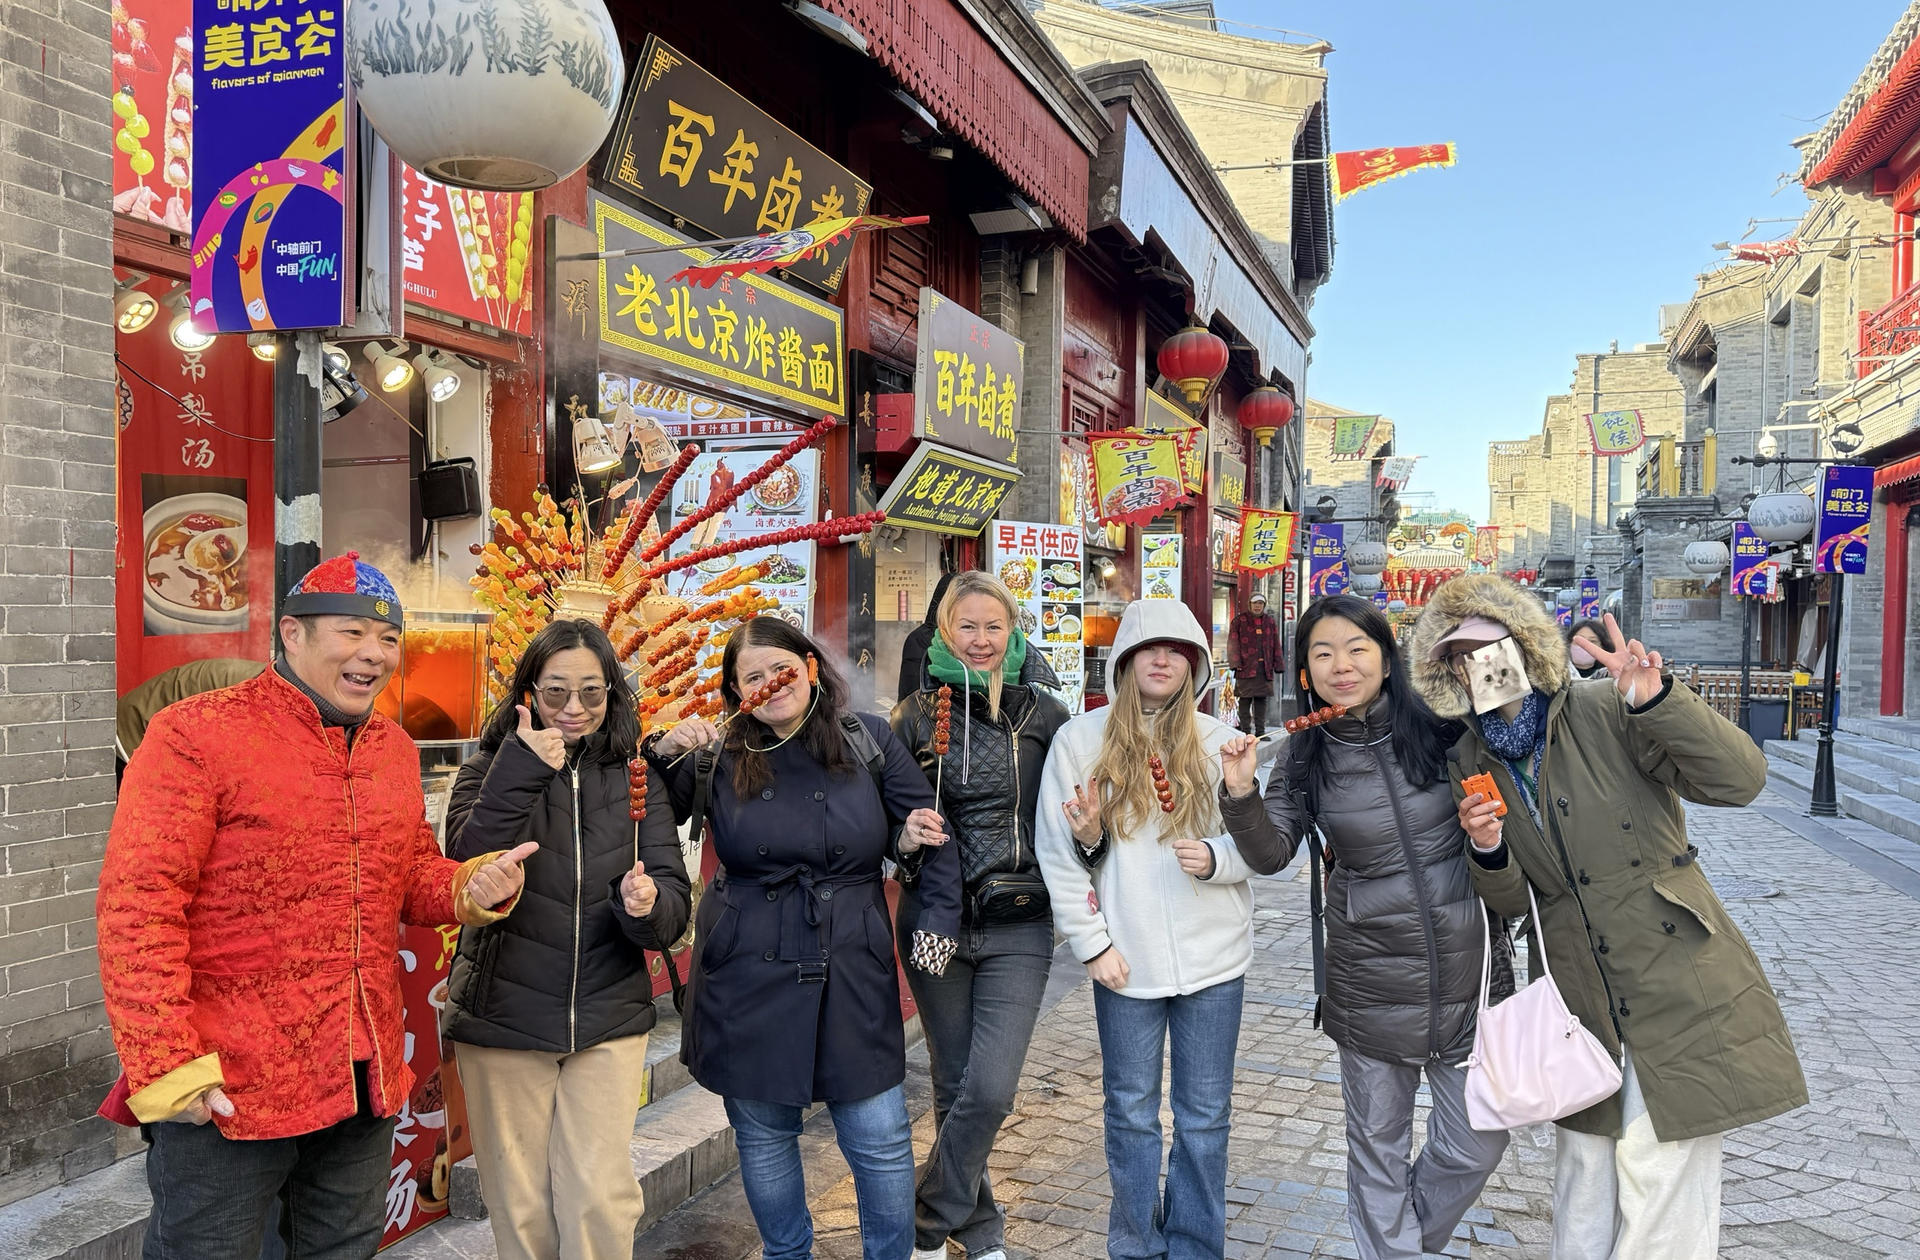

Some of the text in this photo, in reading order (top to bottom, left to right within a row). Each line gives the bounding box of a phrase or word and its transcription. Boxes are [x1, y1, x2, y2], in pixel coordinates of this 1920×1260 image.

[203, 9, 336, 72] 美食谷
[719, 275, 757, 306] 正宗
[614, 263, 835, 397] 老北京炸酱面
[969, 324, 991, 351] 正宗
[933, 349, 1017, 443] 百年卤煮
[906, 464, 1006, 514] 地道北京味
[1116, 447, 1162, 513] 百年卤煮
[755, 516, 799, 528] 卤煮火烧
[902, 502, 938, 520] Authentic
[998, 525, 1080, 559] 早点供应
[1249, 518, 1281, 566] 门框卤煮
